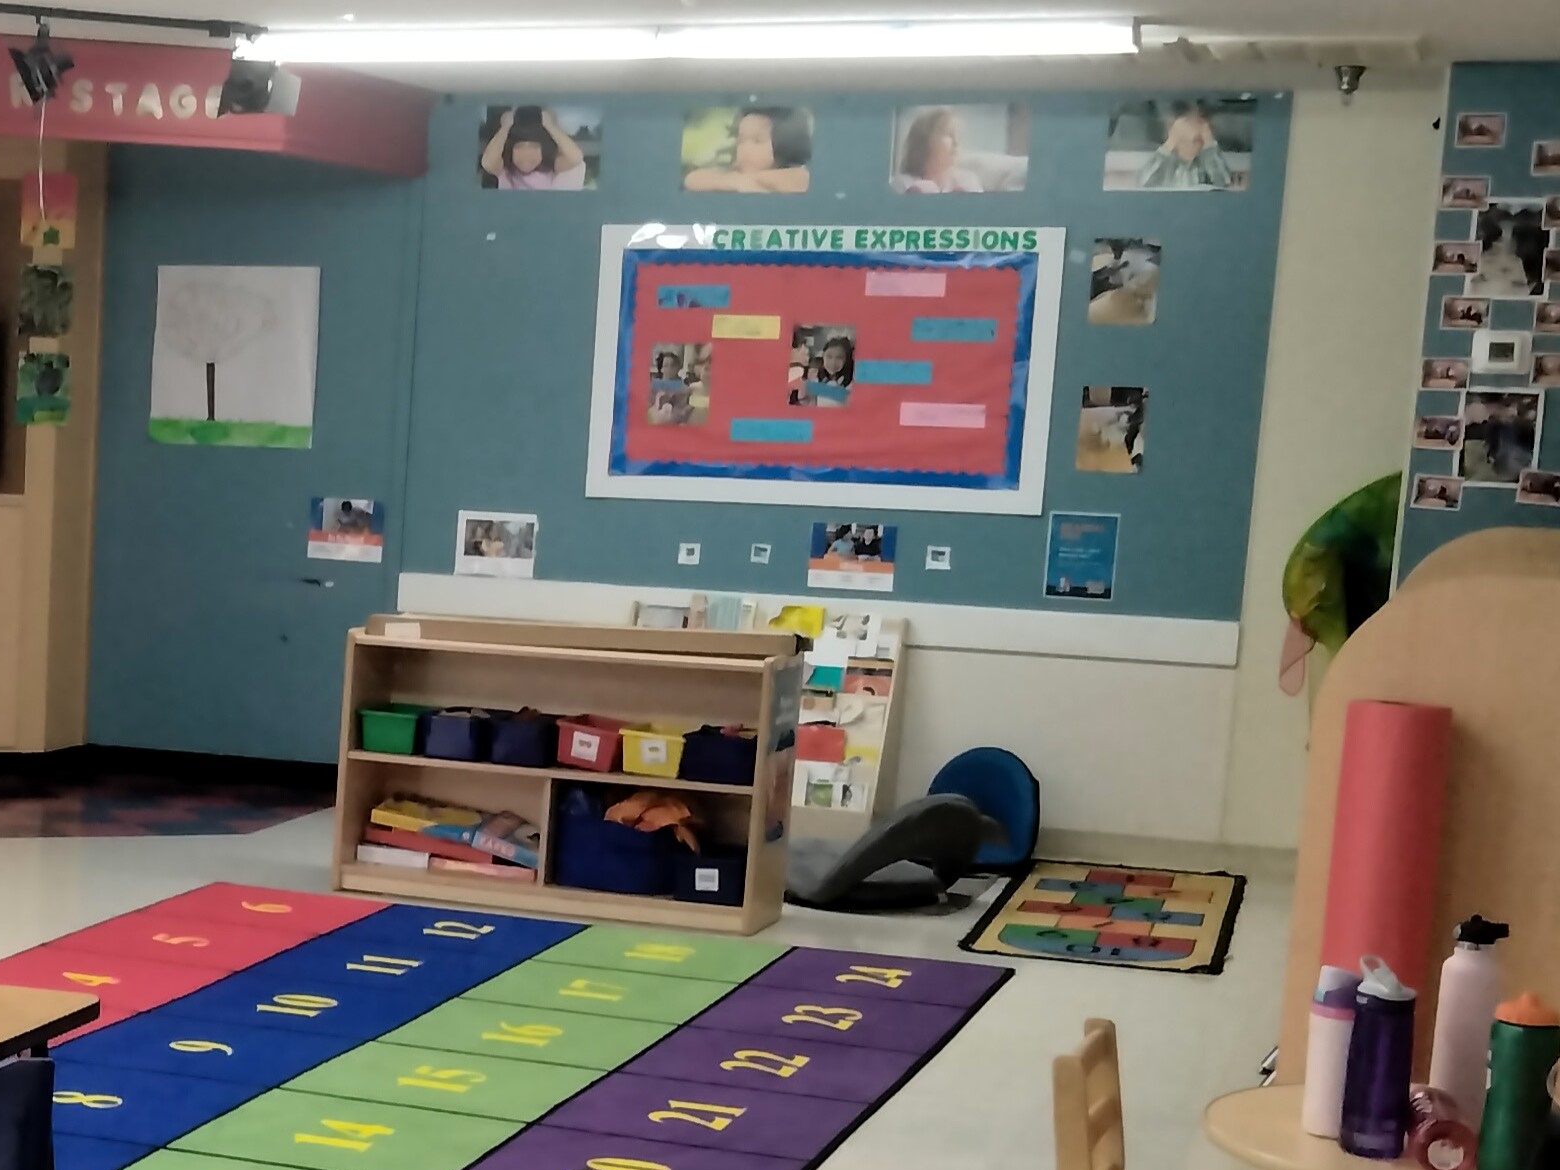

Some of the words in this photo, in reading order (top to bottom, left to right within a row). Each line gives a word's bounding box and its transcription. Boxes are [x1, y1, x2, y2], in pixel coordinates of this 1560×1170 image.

[712, 228, 844, 251] CREATIVE
[855, 228, 1038, 251] EXPRESSIONS
[242, 901, 292, 913] 6
[152, 933, 210, 948] 5
[422, 921, 496, 940] 12
[346, 954, 423, 975] 11
[62, 972, 121, 986] 4
[835, 965, 912, 989] 24
[558, 978, 630, 1001] 17
[256, 994, 338, 1017] 10
[781, 1004, 863, 1031] 23
[481, 1022, 565, 1047] 16
[169, 1040, 233, 1056] 9
[720, 1050, 810, 1078] 22
[397, 1065, 488, 1093] 15
[52, 1091, 123, 1108] 8
[648, 1100, 747, 1131] 21
[294, 1119, 395, 1151] 14
